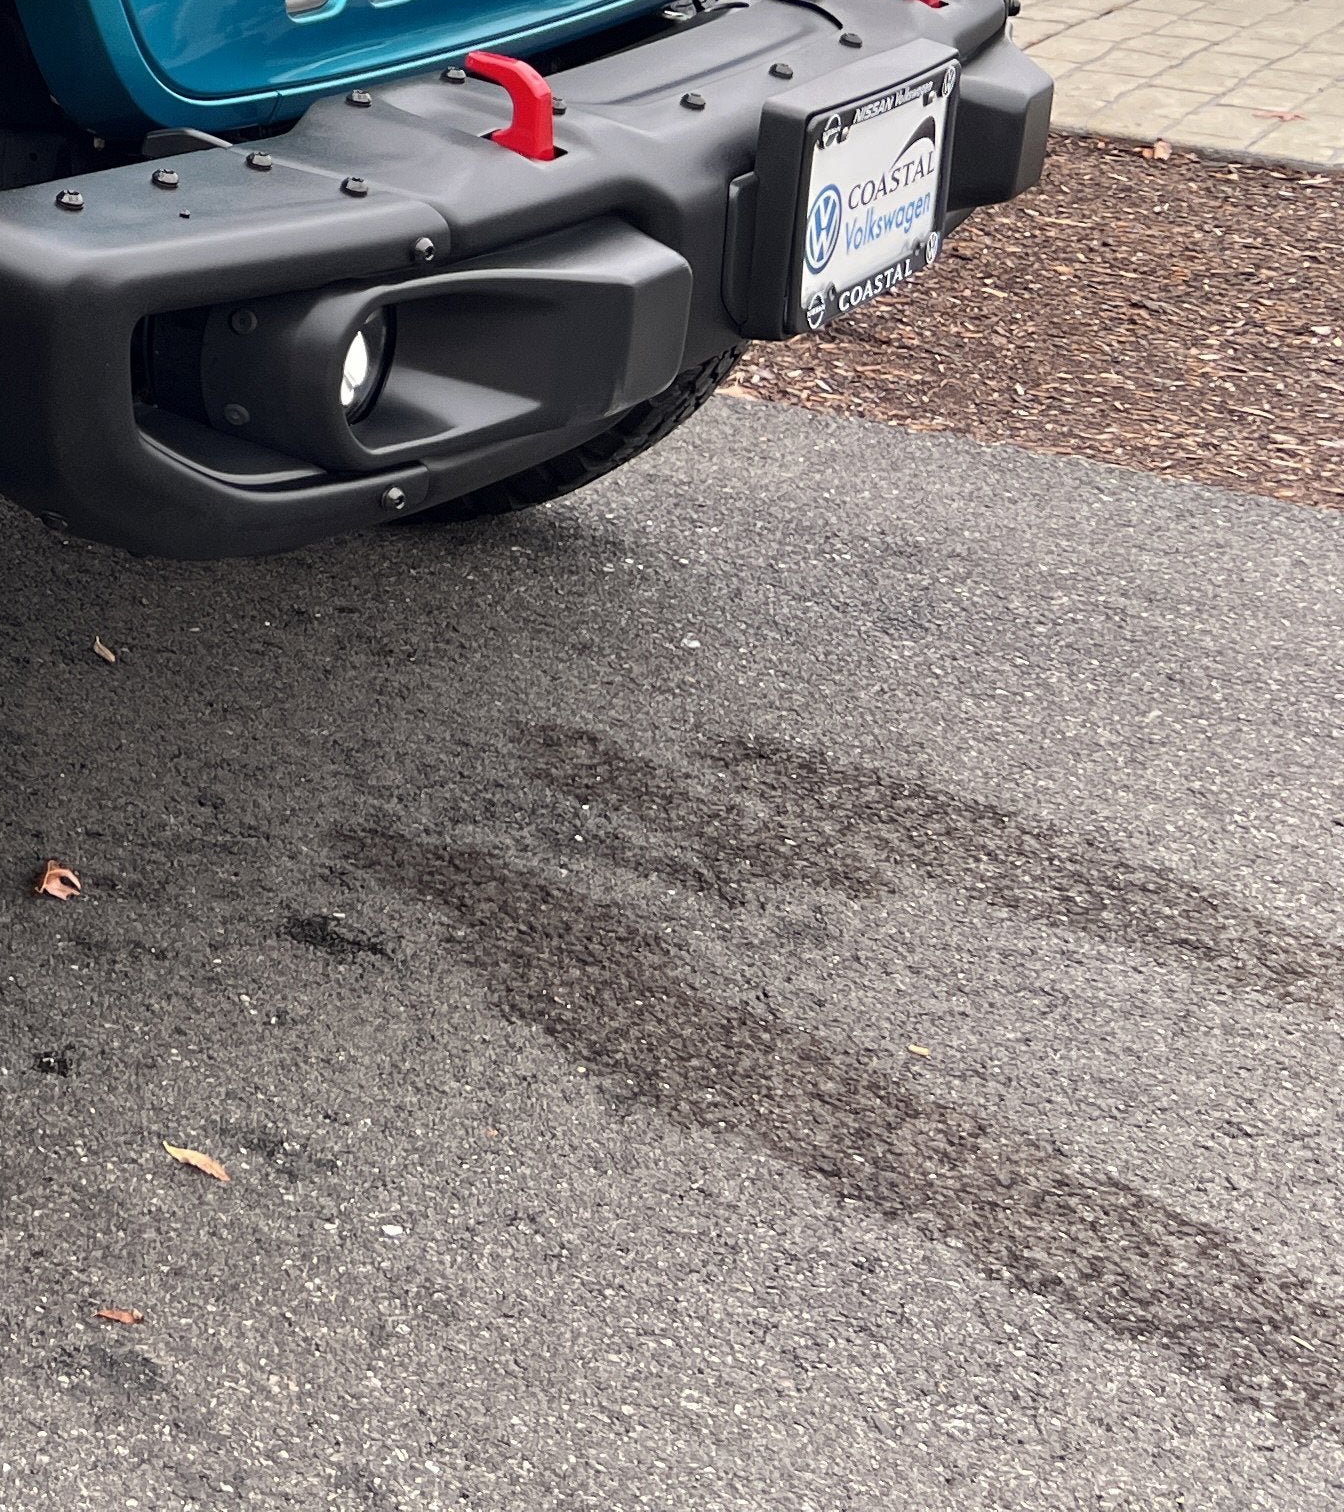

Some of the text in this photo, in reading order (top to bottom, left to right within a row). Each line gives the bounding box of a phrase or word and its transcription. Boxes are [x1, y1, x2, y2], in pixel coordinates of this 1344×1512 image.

[852, 96, 895, 125] NISSAN
[847, 150, 935, 210] COASTAL
[807, 187, 841, 271] VW
[845, 191, 931, 255] Volkswagen
[838, 258, 913, 312] COASTAL
